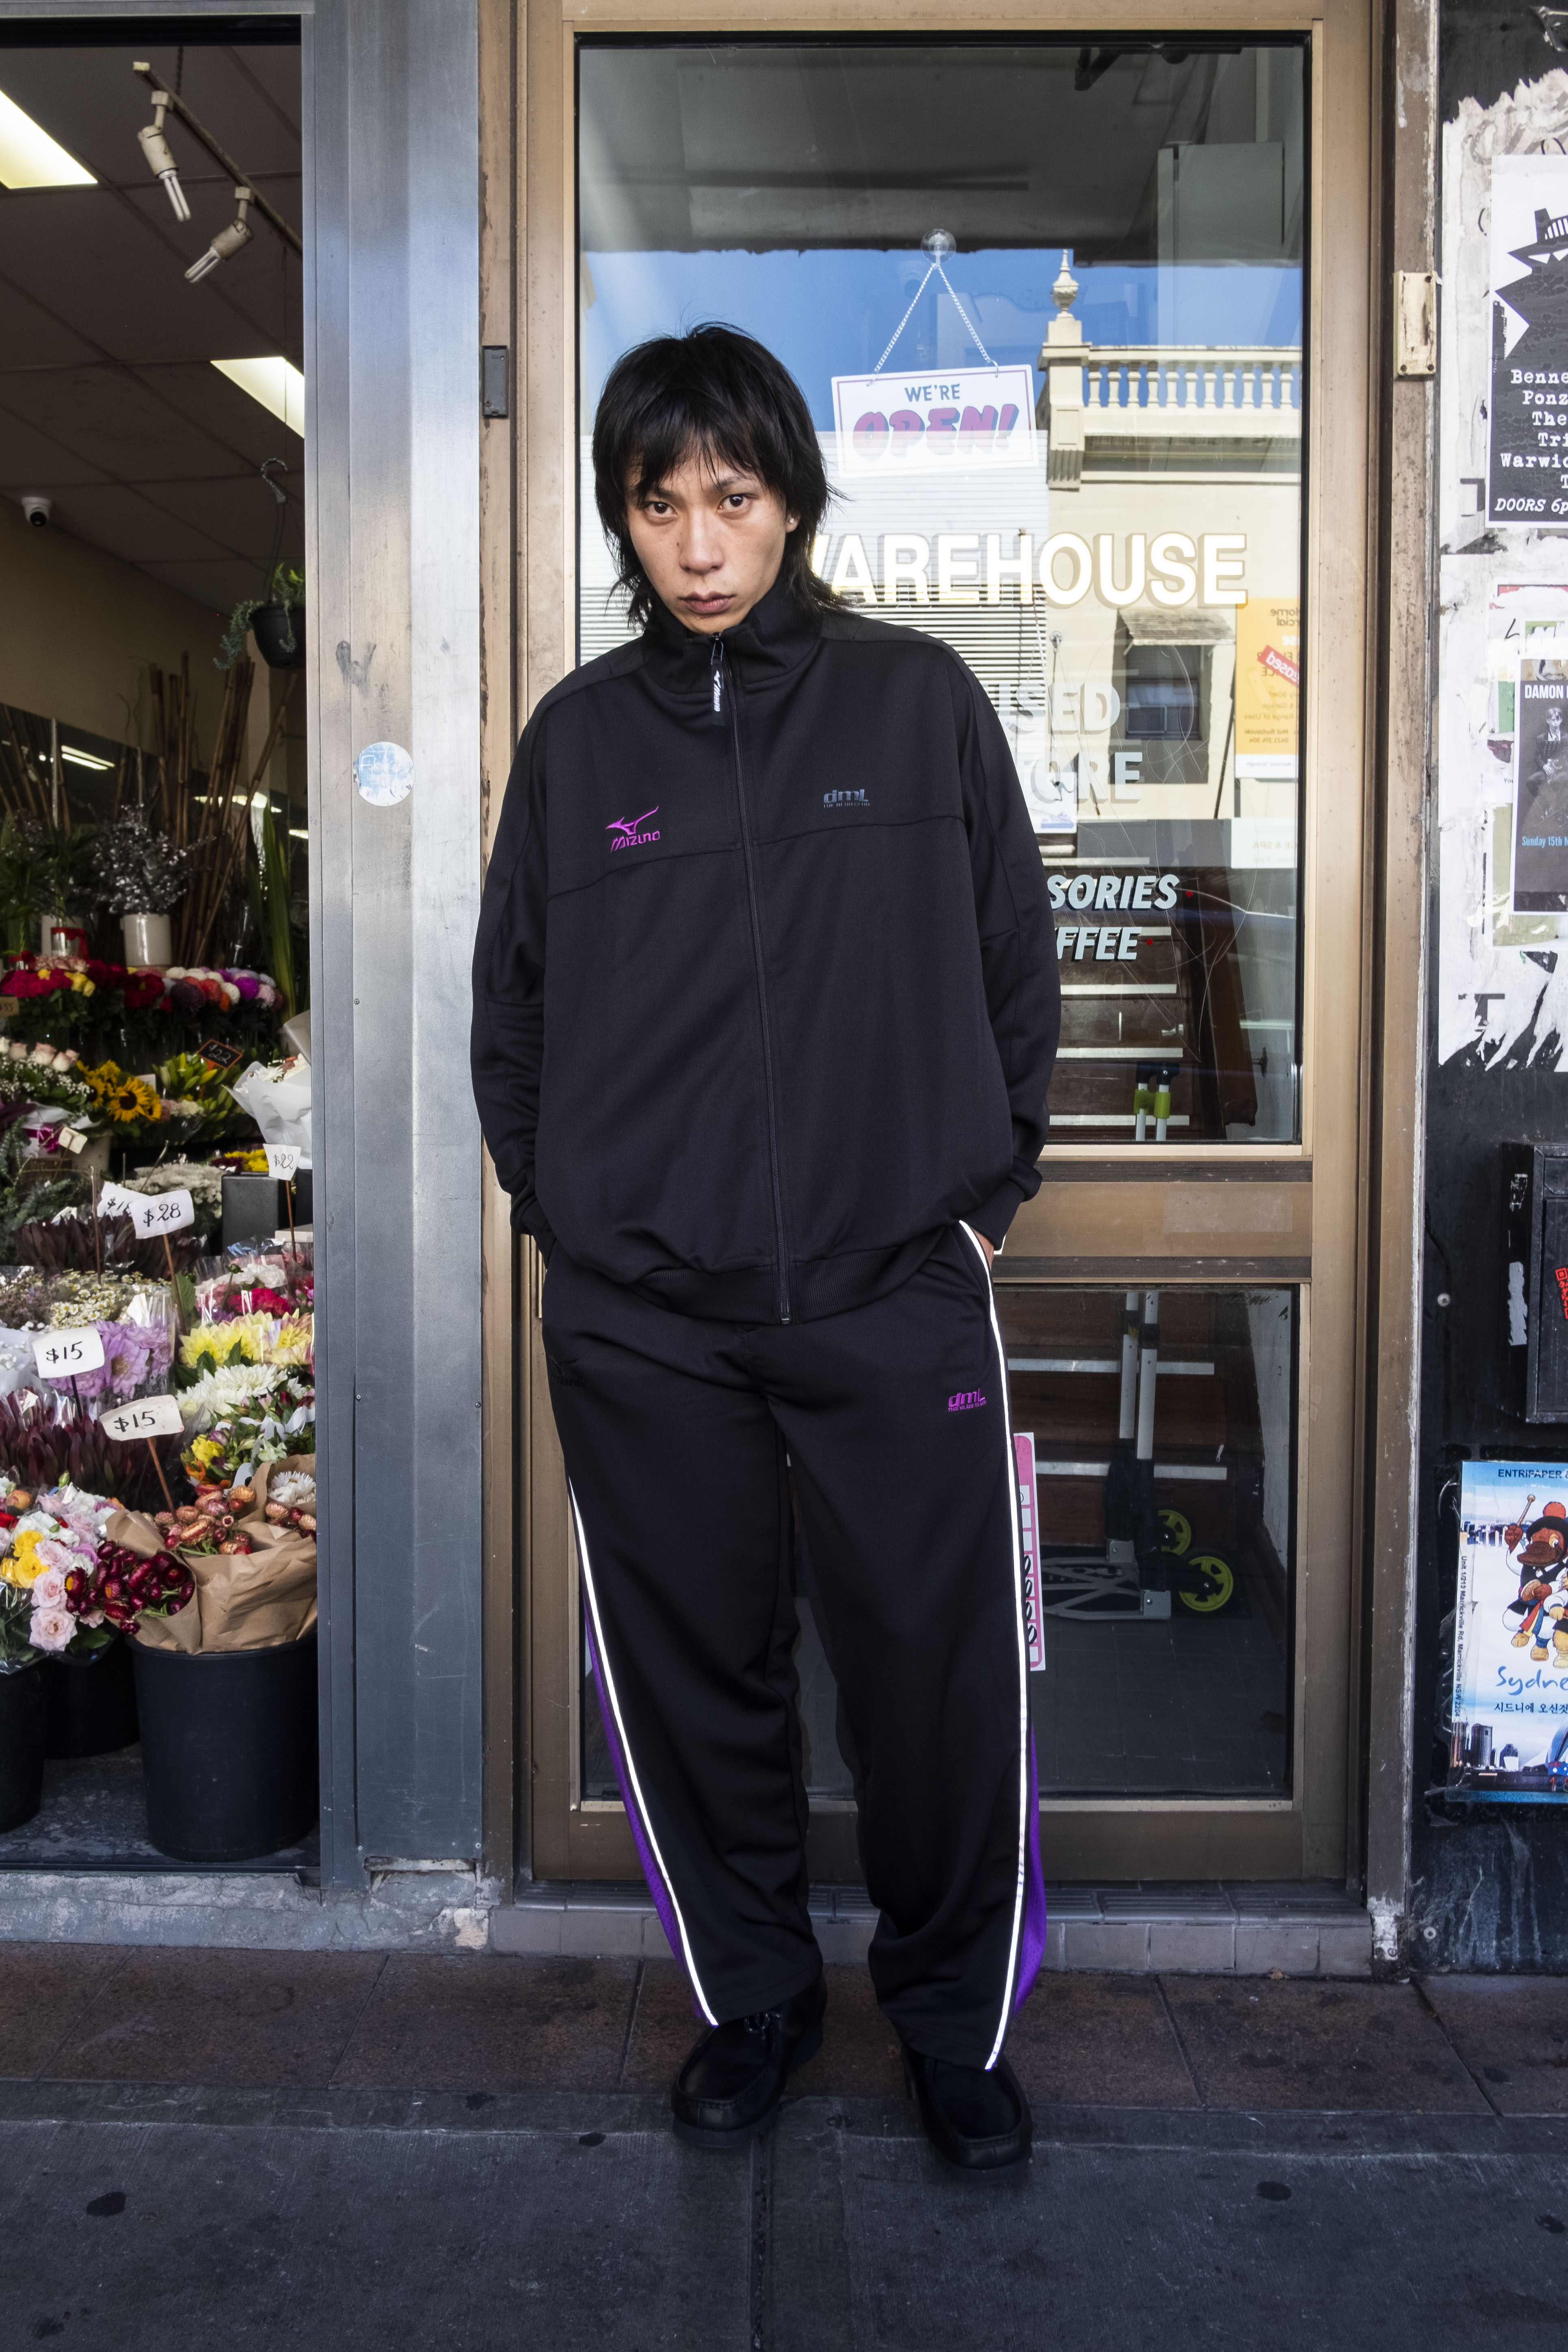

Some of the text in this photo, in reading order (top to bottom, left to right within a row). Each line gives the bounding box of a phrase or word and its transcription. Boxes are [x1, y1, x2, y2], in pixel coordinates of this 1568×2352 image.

[1511, 369, 1568, 383] Benne
[905, 383, 960, 402] WE'RE
[1522, 390, 1568, 405] Ponz
[1532, 411, 1567, 426] The
[853, 404, 1019, 461] OPEN!
[1494, 498, 1546, 512] DOORS
[1525, 685, 1563, 699] DAMON
[1027, 752, 1142, 803] ORE
[1522, 835, 1546, 848] Sunday
[1548, 836, 1562, 846] 15th
[1047, 874, 1180, 910] SORIES
[1056, 926, 1142, 961] FFEE
[273, 1153, 293, 1170] $22
[143, 1203, 181, 1227] $28
[46, 1341, 82, 1364] $15
[113, 1411, 156, 1432] $15
[1498, 1469, 1562, 1478] ENTRIPAPER
[1495, 1666, 1568, 1696] Sydne
[1494, 1702, 1534, 1714] 시드니에
